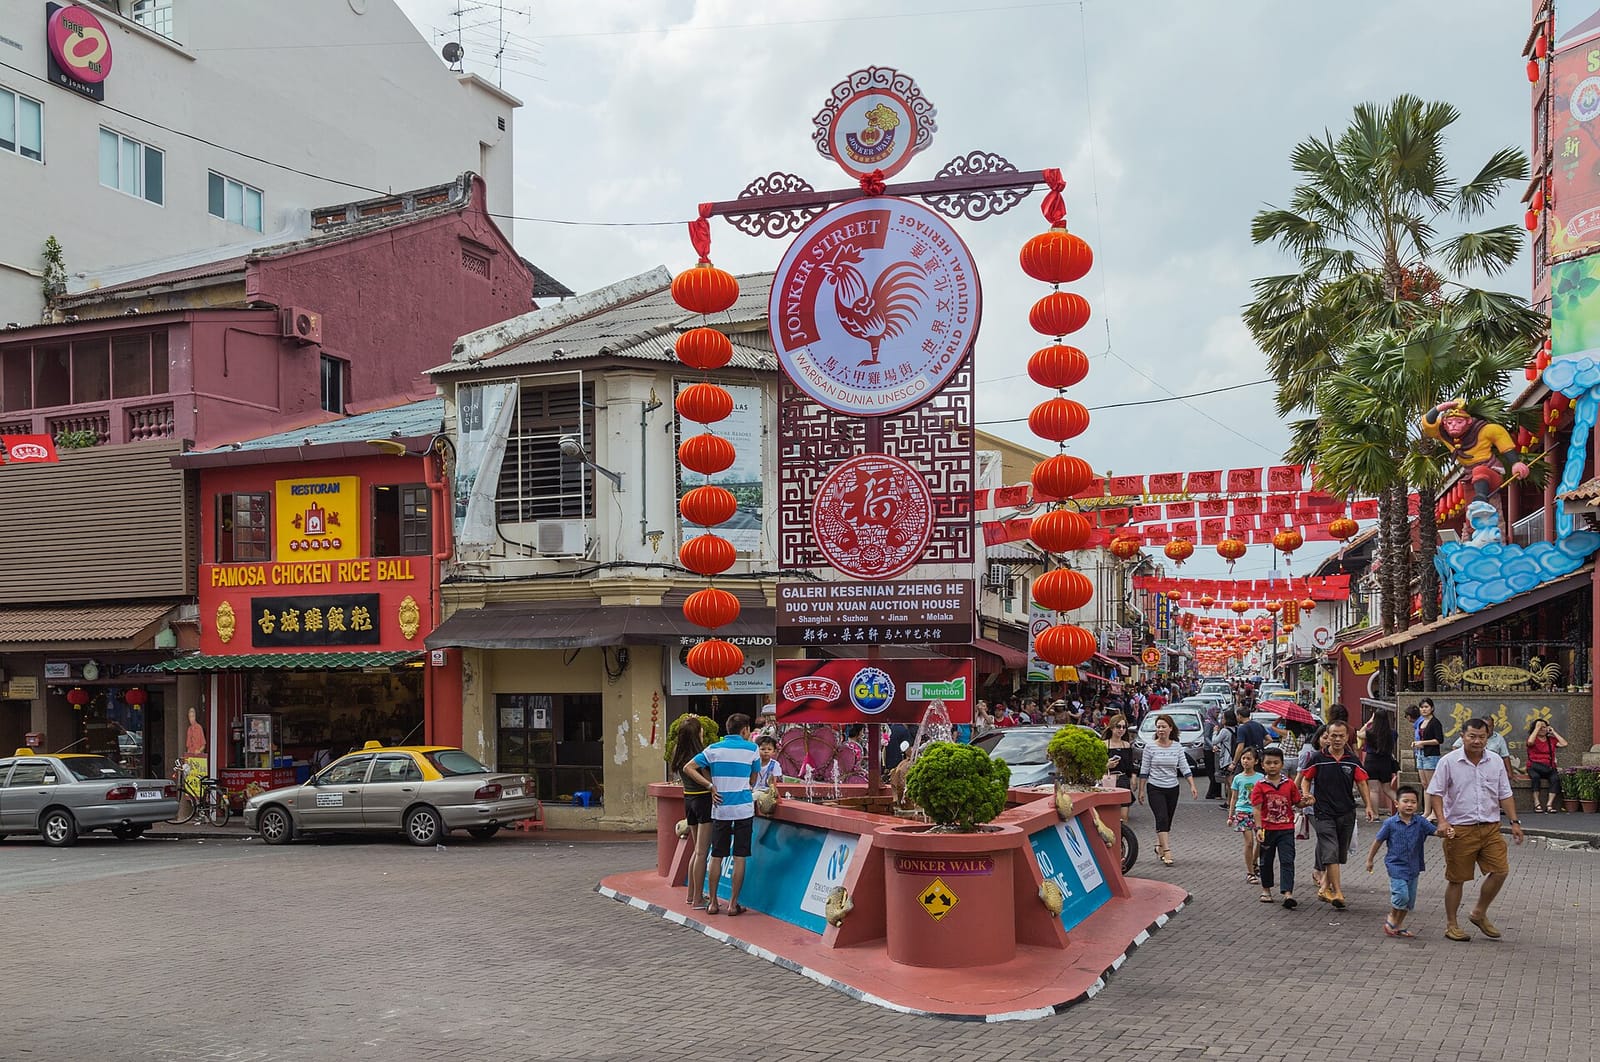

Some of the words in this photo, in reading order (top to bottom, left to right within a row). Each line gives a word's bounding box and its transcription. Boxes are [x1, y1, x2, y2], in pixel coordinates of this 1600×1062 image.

[848, 136, 874, 156] JONKER
[875, 134, 893, 153] WALK
[898, 214, 953, 256] HERITAGE
[786, 258, 815, 342] JONKER
[812, 219, 881, 260] STREET
[949, 255, 968, 325] CULTURAL
[929, 329, 963, 376] WORLD
[796, 353, 837, 395] WARISAN
[837, 389, 875, 405] DUNIA
[877, 380, 925, 405] UNESCO
[291, 482, 340, 496] RESTORAN
[211, 565, 266, 587] FAMOSA
[271, 563, 331, 585] CHICKEN
[338, 561, 370, 582] RICE
[377, 559, 415, 580] BALL
[782, 587, 827, 598] GALERI
[830, 585, 894, 597] KESENIAN
[897, 585, 942, 596] ZHENG
[946, 584, 964, 595] HE
[786, 602, 808, 612] DUO
[811, 602, 834, 612] YUN
[837, 601, 868, 611] XUAN
[870, 600, 919, 611] AUCTION
[922, 599, 961, 609] HOUSE
[798, 615, 832, 625] Shanghai
[888, 614, 908, 622] Jinan
[926, 613, 954, 621] Melaka
[855, 683, 888, 699] G.L.
[910, 687, 921, 697] Dr
[924, 686, 960, 697] Nutrition
[900, 859, 946, 871] JONKER
[950, 860, 987, 871] WALK
